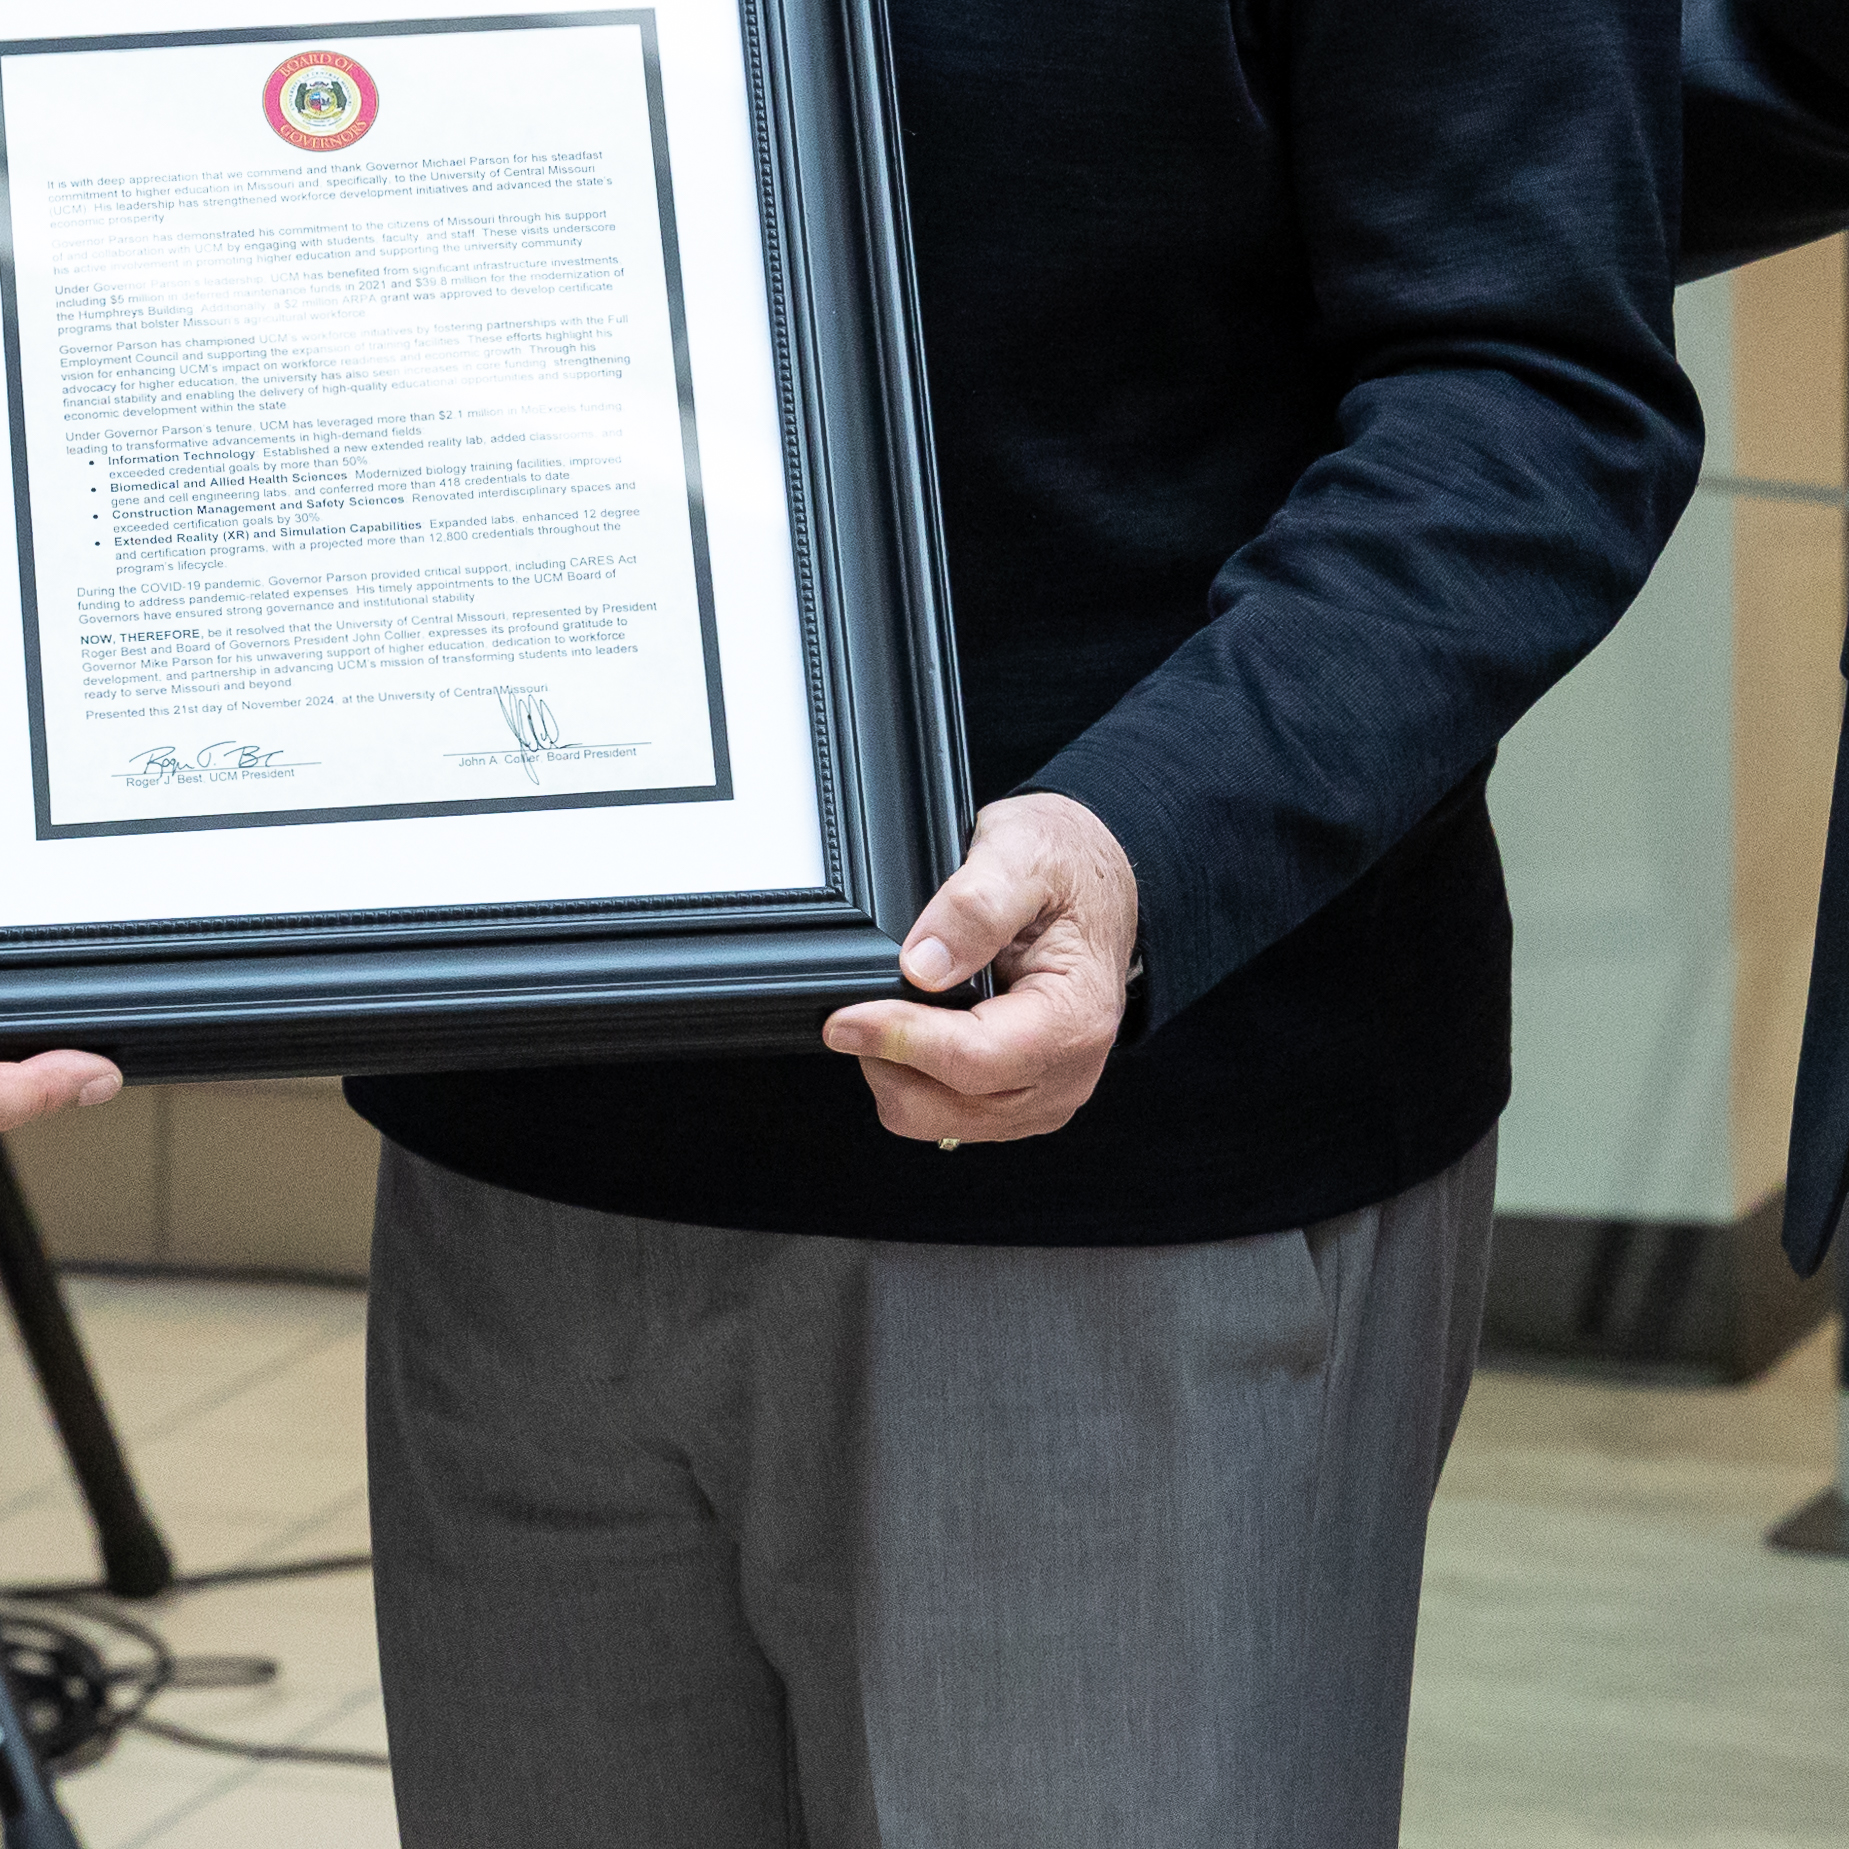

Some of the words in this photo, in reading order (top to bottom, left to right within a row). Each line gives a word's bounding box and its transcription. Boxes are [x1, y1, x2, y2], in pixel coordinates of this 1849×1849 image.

[279, 52, 332, 78] BOARD
[334, 55, 357, 72] OF
[279, 119, 367, 149] GOVERNORS
[46, 180, 54, 189] It
[57, 180, 67, 188] is
[69, 177, 93, 187] with
[96, 175, 125, 187] deep
[128, 173, 198, 185] appreciation
[201, 170, 223, 180] that
[245, 166, 303, 178] commend
[305, 164, 327, 174] and
[330, 163, 361, 172] thank
[364, 159, 418, 171] Governor
[421, 156, 466, 168] Michael
[468, 154, 510, 166] Parson
[512, 152, 528, 163] for
[530, 152, 548, 162] his
[550, 149, 603, 161] steadfast
[107, 451, 179, 465] Information
[262, 444, 330, 457] Established
[332, 445, 340, 453] a
[343, 442, 368, 453] new
[370, 438, 424, 451] extended
[426, 436, 462, 449] reality
[489, 432, 526, 444] added
[600, 427, 623, 438] and
[108, 466, 165, 479] exceeded
[167, 462, 225, 475] credential
[227, 461, 260, 474] goals
[262, 460, 277, 473] by
[279, 460, 310, 470] more
[312, 457, 339, 468] than
[109, 479, 179, 493] Biomedical
[182, 477, 206, 488] and
[208, 475, 245, 487] Allied
[247, 473, 288, 485] Health
[354, 465, 422, 479] Modernized
[424, 463, 467, 477] biology
[469, 461, 513, 473] training
[568, 455, 622, 467] improved
[110, 496, 140, 508] gene
[142, 493, 165, 504] and
[167, 492, 189, 503] cell
[190, 490, 260, 504] engineering
[293, 485, 316, 496] and
[318, 482, 374, 495] conferred
[376, 482, 407, 492] more
[409, 479, 436, 489] than
[438, 476, 461, 487] 418
[463, 472, 527, 486] credentials
[529, 472, 542, 481] to
[111, 505, 193, 520] Construction
[196, 500, 276, 517] Management
[278, 499, 303, 510] and
[305, 496, 345, 511] Safety
[411, 489, 474, 503] Renovated
[477, 484, 567, 499] interdisciplinary
[569, 483, 611, 494] spaces
[614, 481, 636, 490] and
[112, 520, 169, 533] exceeded
[172, 516, 239, 530] certification
[241, 515, 274, 528] goals
[276, 513, 291, 526] by
[113, 533, 173, 546] Extended
[175, 531, 219, 545] Reality
[222, 529, 250, 542] (XR)
[252, 528, 276, 538] and
[279, 523, 346, 537] Simulation
[428, 515, 487, 529] Expanded
[521, 510, 579, 522] enhanced
[584, 508, 596, 519] 12
[599, 507, 640, 520] degree
[114, 550, 137, 560] and
[139, 545, 206, 559] certification
[271, 541, 295, 551] with
[298, 542, 306, 550] a
[308, 537, 364, 551] projected
[366, 536, 396, 546] more
[398, 533, 425, 544] than
[429, 530, 469, 543] 12,800
[470, 526, 534, 540] credentials
[536, 522, 600, 537] throughout
[602, 521, 621, 531] the
[115, 563, 174, 576] program's
[80, 646, 116, 661] Roger
[119, 645, 147, 656] Best
[149, 644, 172, 654] and
[175, 641, 211, 653] Board
[213, 640, 226, 650] of
[228, 636, 290, 650] Governors
[292, 633, 349, 646] President
[351, 631, 381, 643] John
[427, 626, 488, 638] expresses
[490, 624, 504, 634] its
[506, 620, 559, 634] profound
[561, 617, 614, 631] gratitude
[615, 616, 628, 626] to
[119, 627, 204, 643] THEREFORE,
[207, 627, 222, 637] be
[225, 627, 232, 636] it
[235, 623, 285, 636] resolved
[288, 622, 311, 632] that
[313, 621, 333, 631] the
[335, 617, 393, 632] University
[396, 616, 408, 626] of
[410, 613, 453, 625] Central
[511, 606, 582, 620] represented
[584, 604, 599, 616] by
[601, 600, 657, 613] President
[84, 706, 145, 720] Presented
[148, 706, 170, 716] this
[172, 703, 199, 715] 21st
[200, 703, 223, 715] day
[225, 701, 238, 711] of
[240, 697, 301, 710] November
[341, 694, 353, 704] at
[355, 693, 375, 703] the
[377, 689, 436, 704] University
[437, 687, 450, 698] of
[457, 755, 486, 767] John
[545, 749, 581, 761] Board
[582, 746, 637, 759] President
[125, 774, 161, 789] Roger
[208, 770, 238, 782] UCM
[240, 767, 295, 780] President
